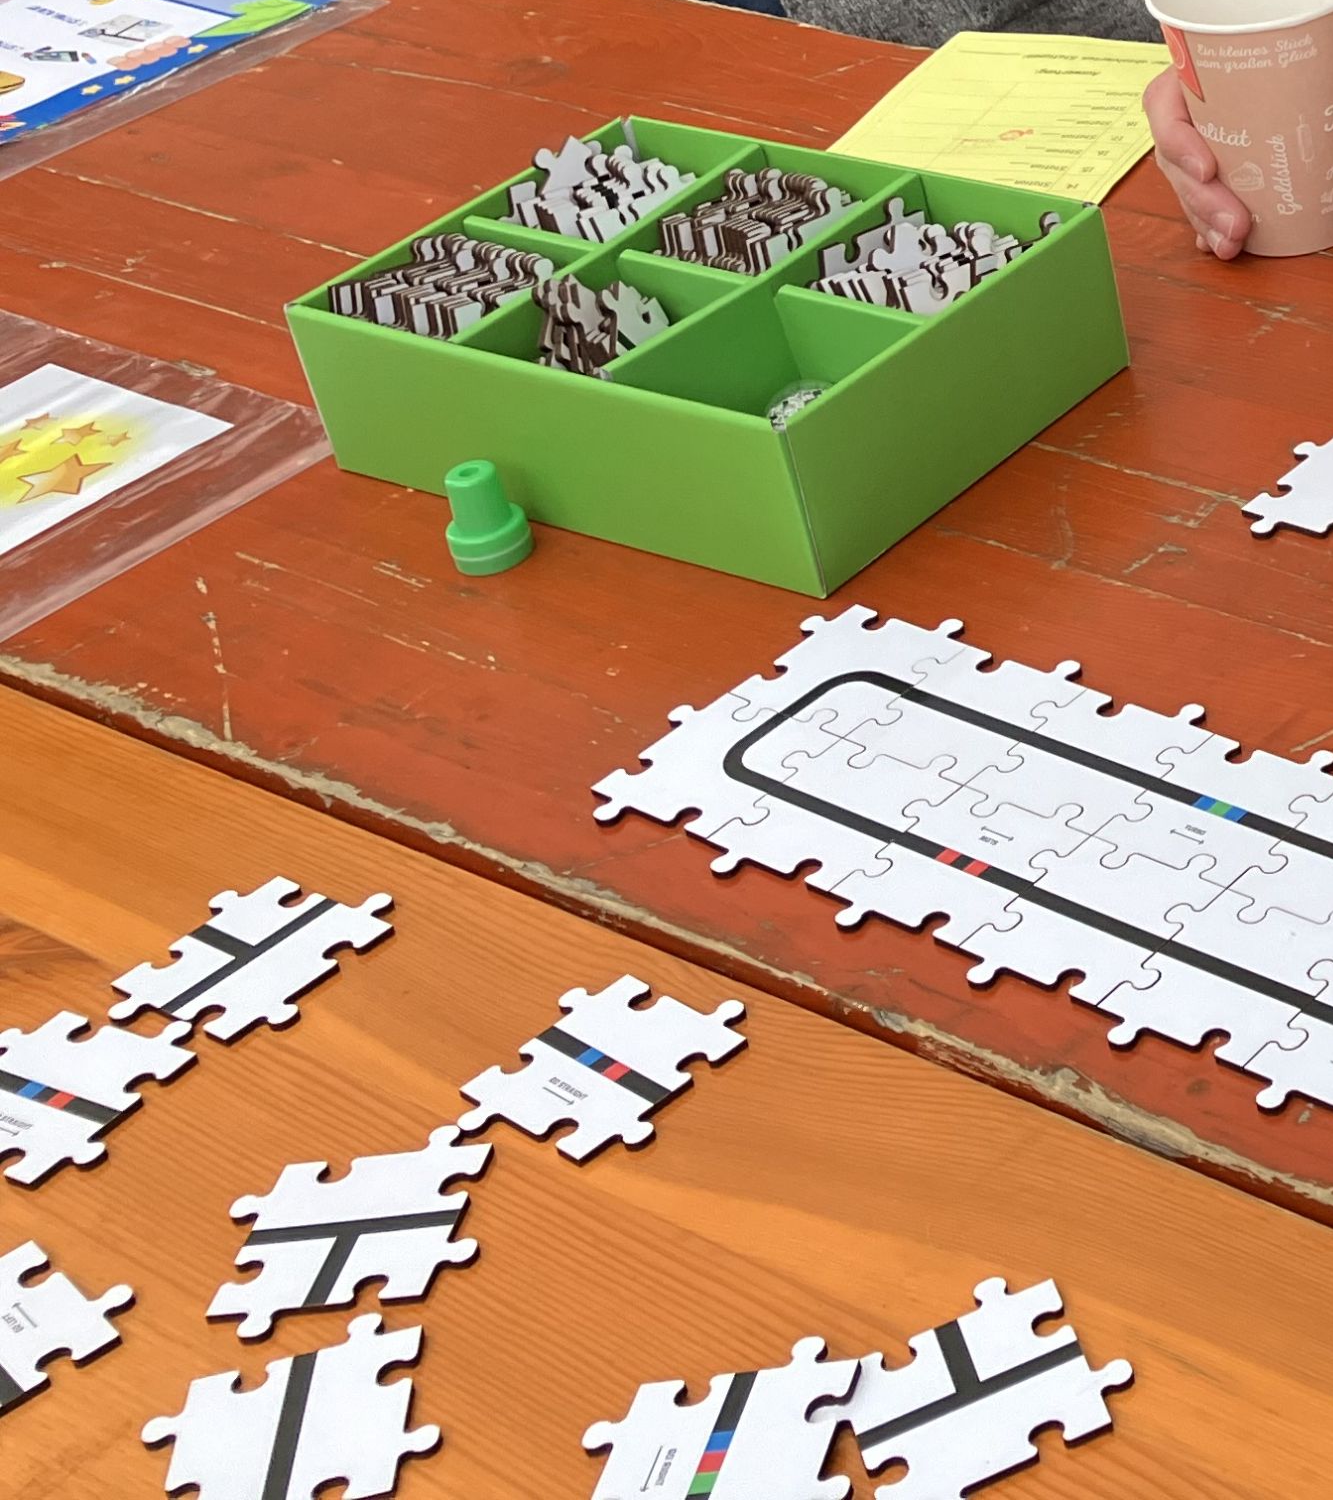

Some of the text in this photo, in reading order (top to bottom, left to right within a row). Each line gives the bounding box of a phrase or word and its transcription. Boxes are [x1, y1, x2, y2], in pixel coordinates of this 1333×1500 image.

[1196, 34, 1314, 57] Ein kleines Stück
[1196, 59, 1222, 70] vom
[1223, 55, 1273, 74] großen
[1266, 134, 1303, 216] Goldstück
[1184, 824, 1207, 836] TURBO
[557, 1081, 590, 1101] STRAIGHT
